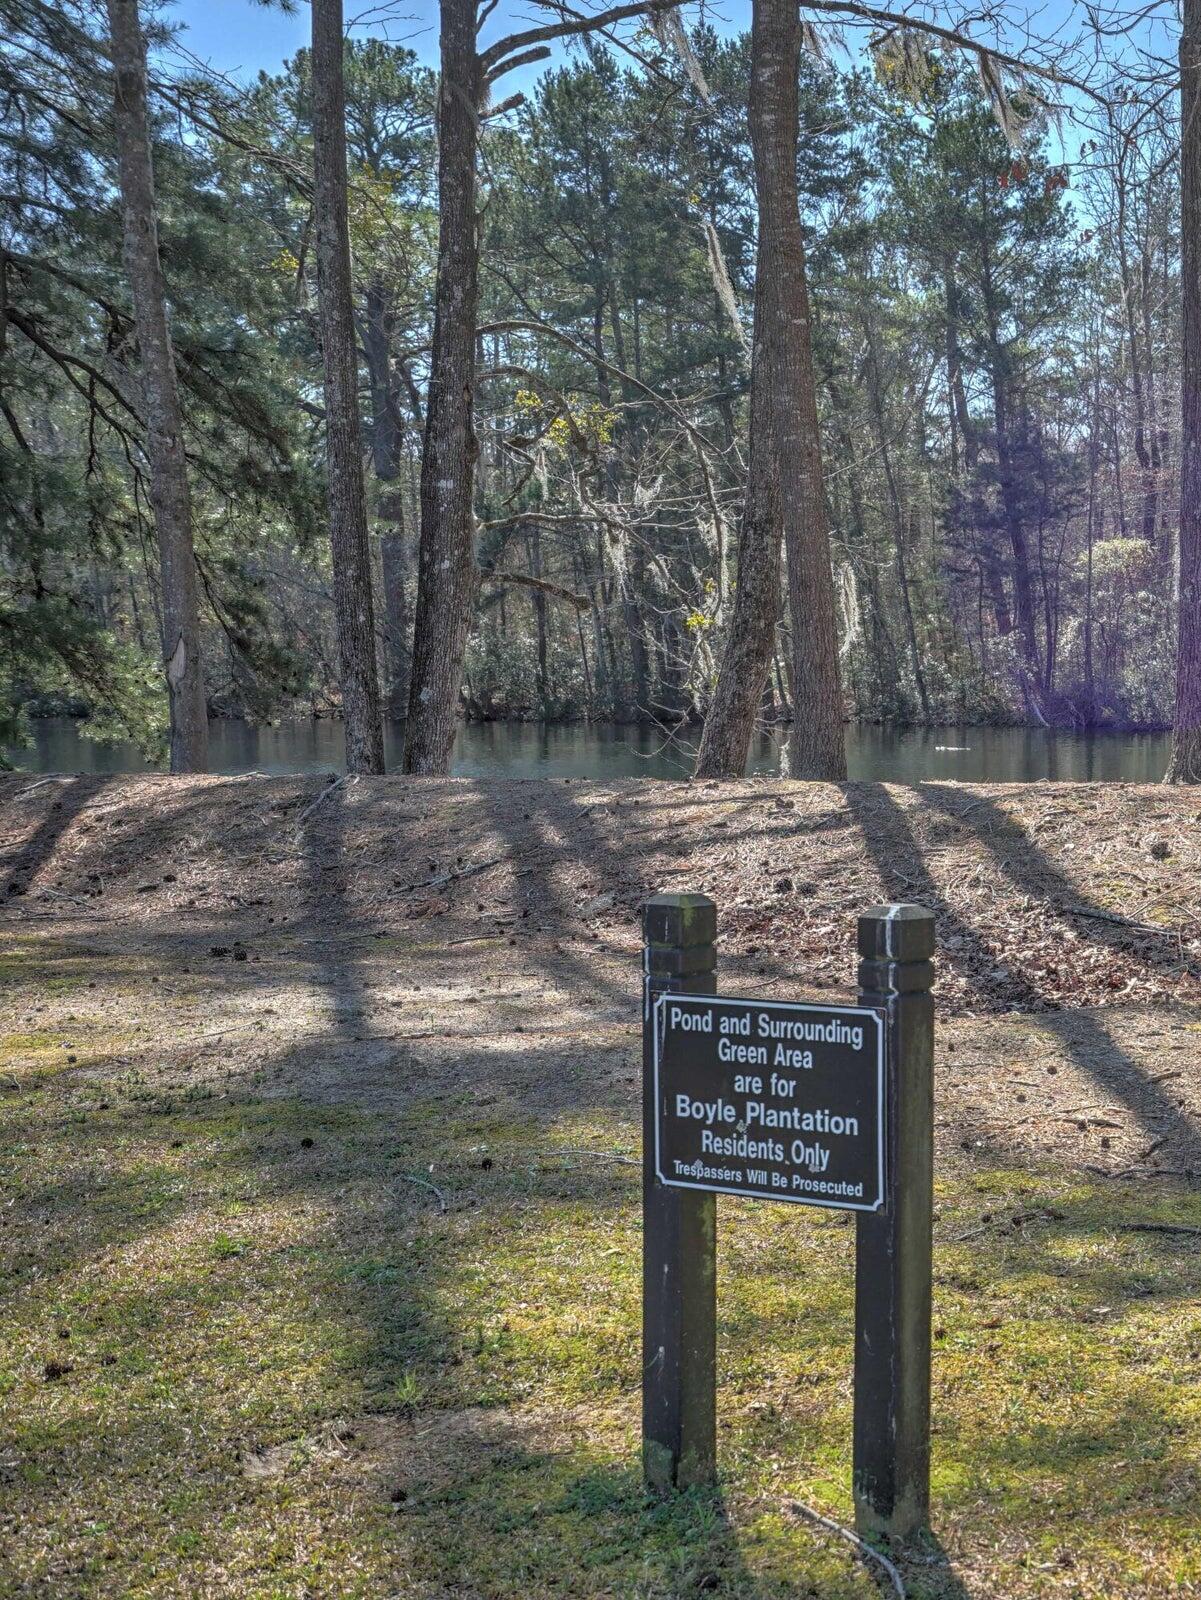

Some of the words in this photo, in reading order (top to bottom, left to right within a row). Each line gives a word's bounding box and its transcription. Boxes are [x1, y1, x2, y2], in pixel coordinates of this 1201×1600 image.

[671, 1007, 713, 1032] Pond
[719, 1013, 751, 1036] and
[757, 1013, 863, 1050] Surrounding
[718, 1038, 767, 1065] Green
[774, 1043, 813, 1069] Area
[734, 1075, 763, 1095] are
[770, 1073, 797, 1098] for
[676, 1095, 736, 1125] Boyle
[746, 1102, 859, 1136] Plantation
[701, 1130, 784, 1162] Residents
[791, 1140, 830, 1172] Only
[673, 1160, 742, 1183] Trespassers
[747, 1169, 768, 1186] Will
[772, 1173, 788, 1188] Be
[792, 1175, 863, 1197] Prosecuted
